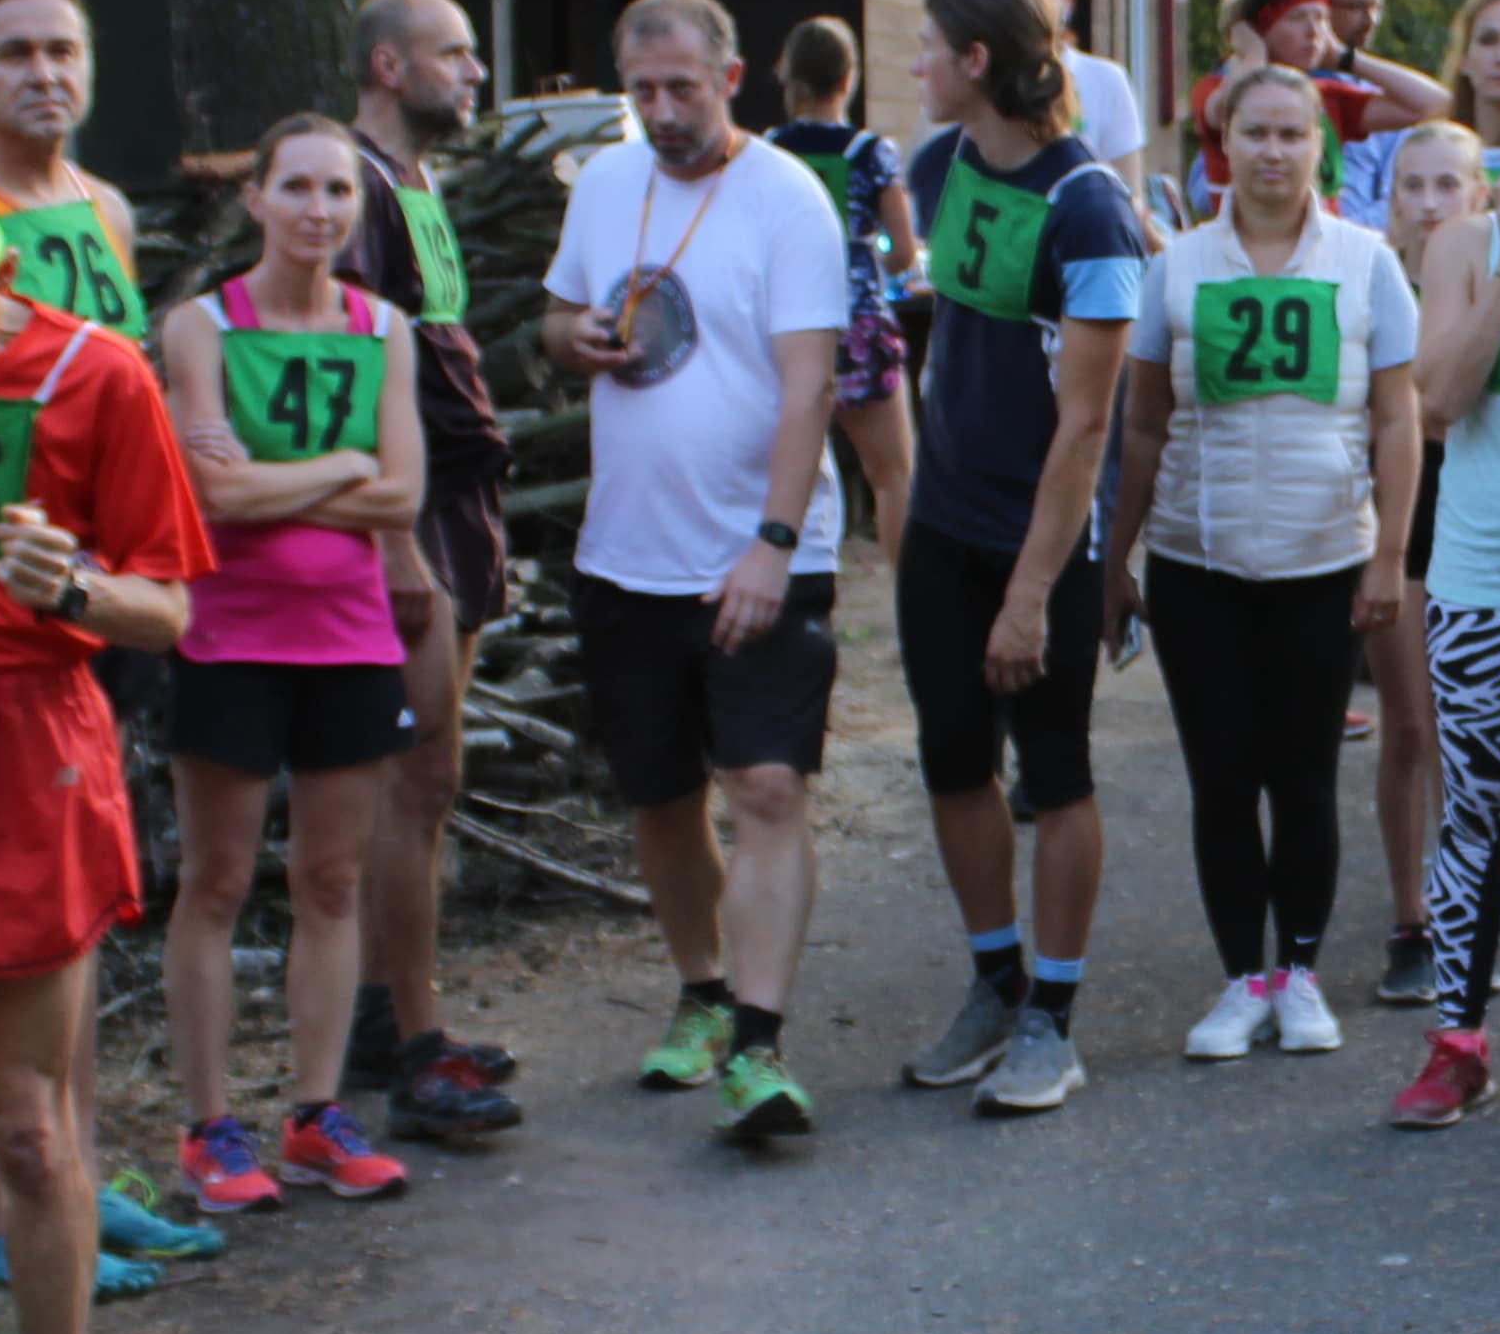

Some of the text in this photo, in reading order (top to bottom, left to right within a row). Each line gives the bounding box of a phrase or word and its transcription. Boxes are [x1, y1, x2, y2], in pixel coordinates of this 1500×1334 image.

[40, 232, 126, 324] 26
[957, 198, 1001, 290] 5
[1225, 296, 1311, 382] 29
[267, 356, 356, 453] 47
